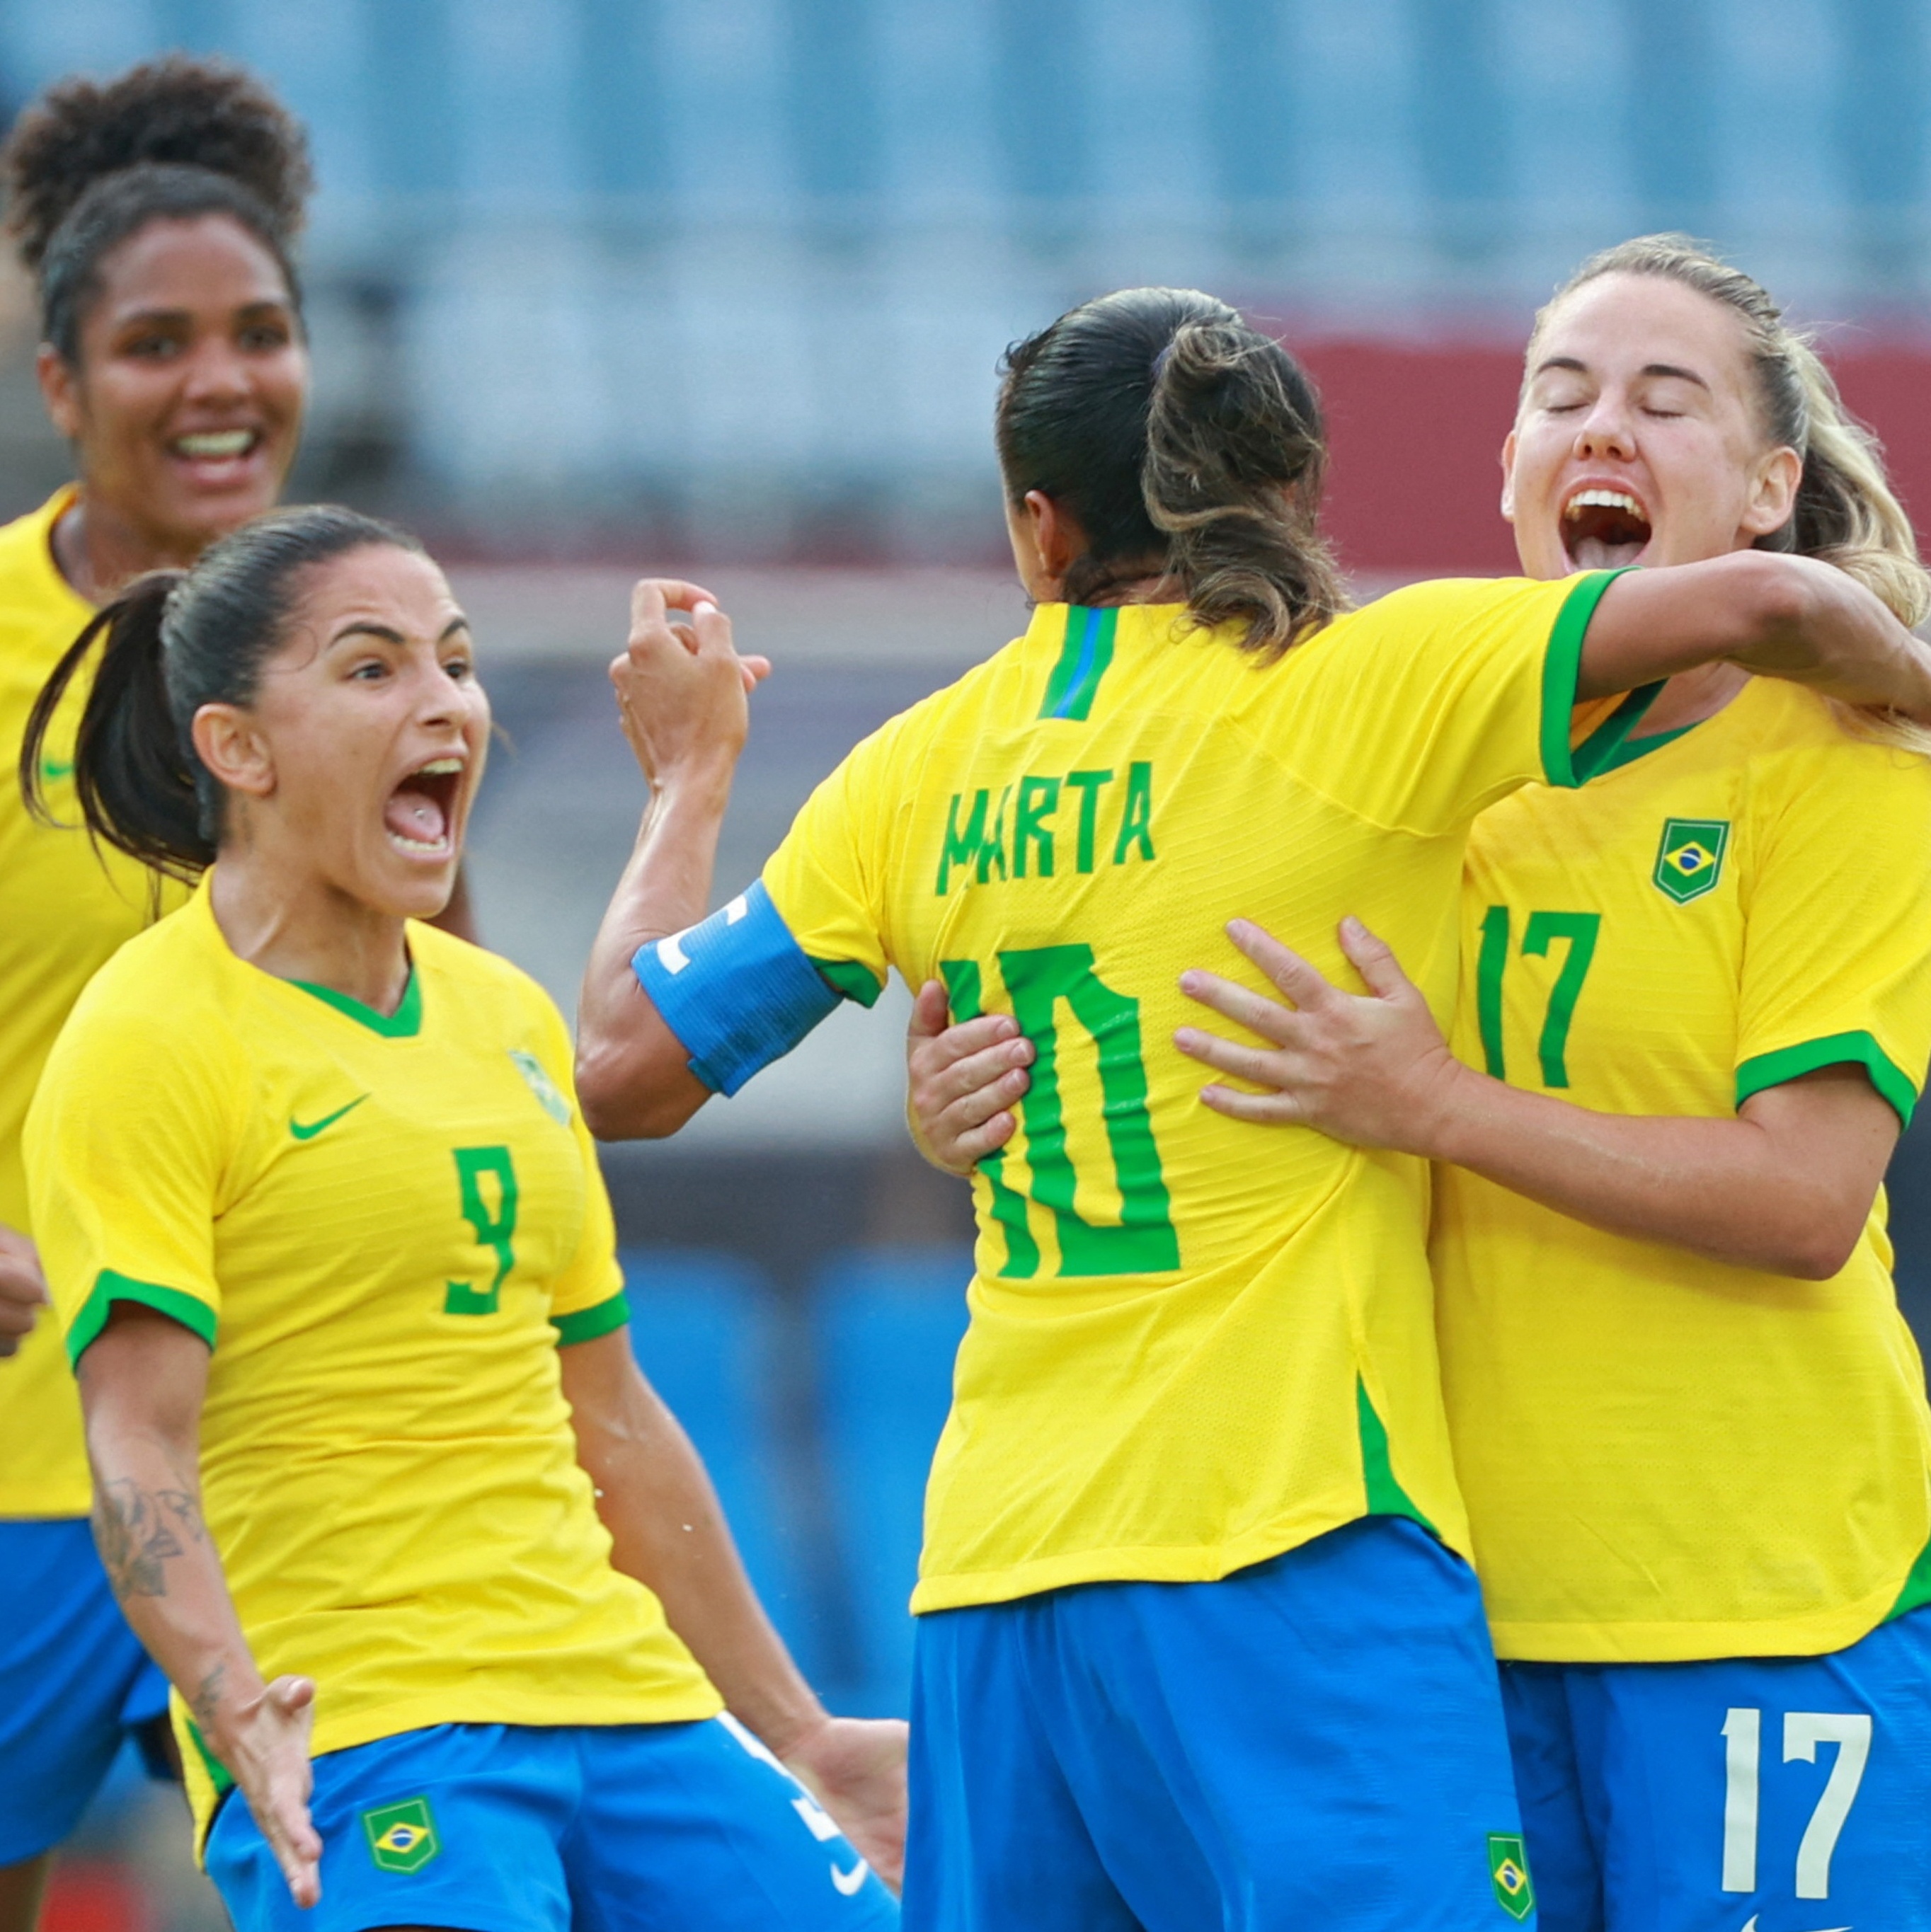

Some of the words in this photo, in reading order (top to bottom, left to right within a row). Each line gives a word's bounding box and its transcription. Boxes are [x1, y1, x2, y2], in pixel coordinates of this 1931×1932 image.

[935, 761, 1155, 896] MARTA
[1477, 905, 1602, 1088] 17
[939, 943, 1181, 1279] 10
[444, 1146, 518, 1315] 9
[1719, 1708, 1872, 1899] 17
